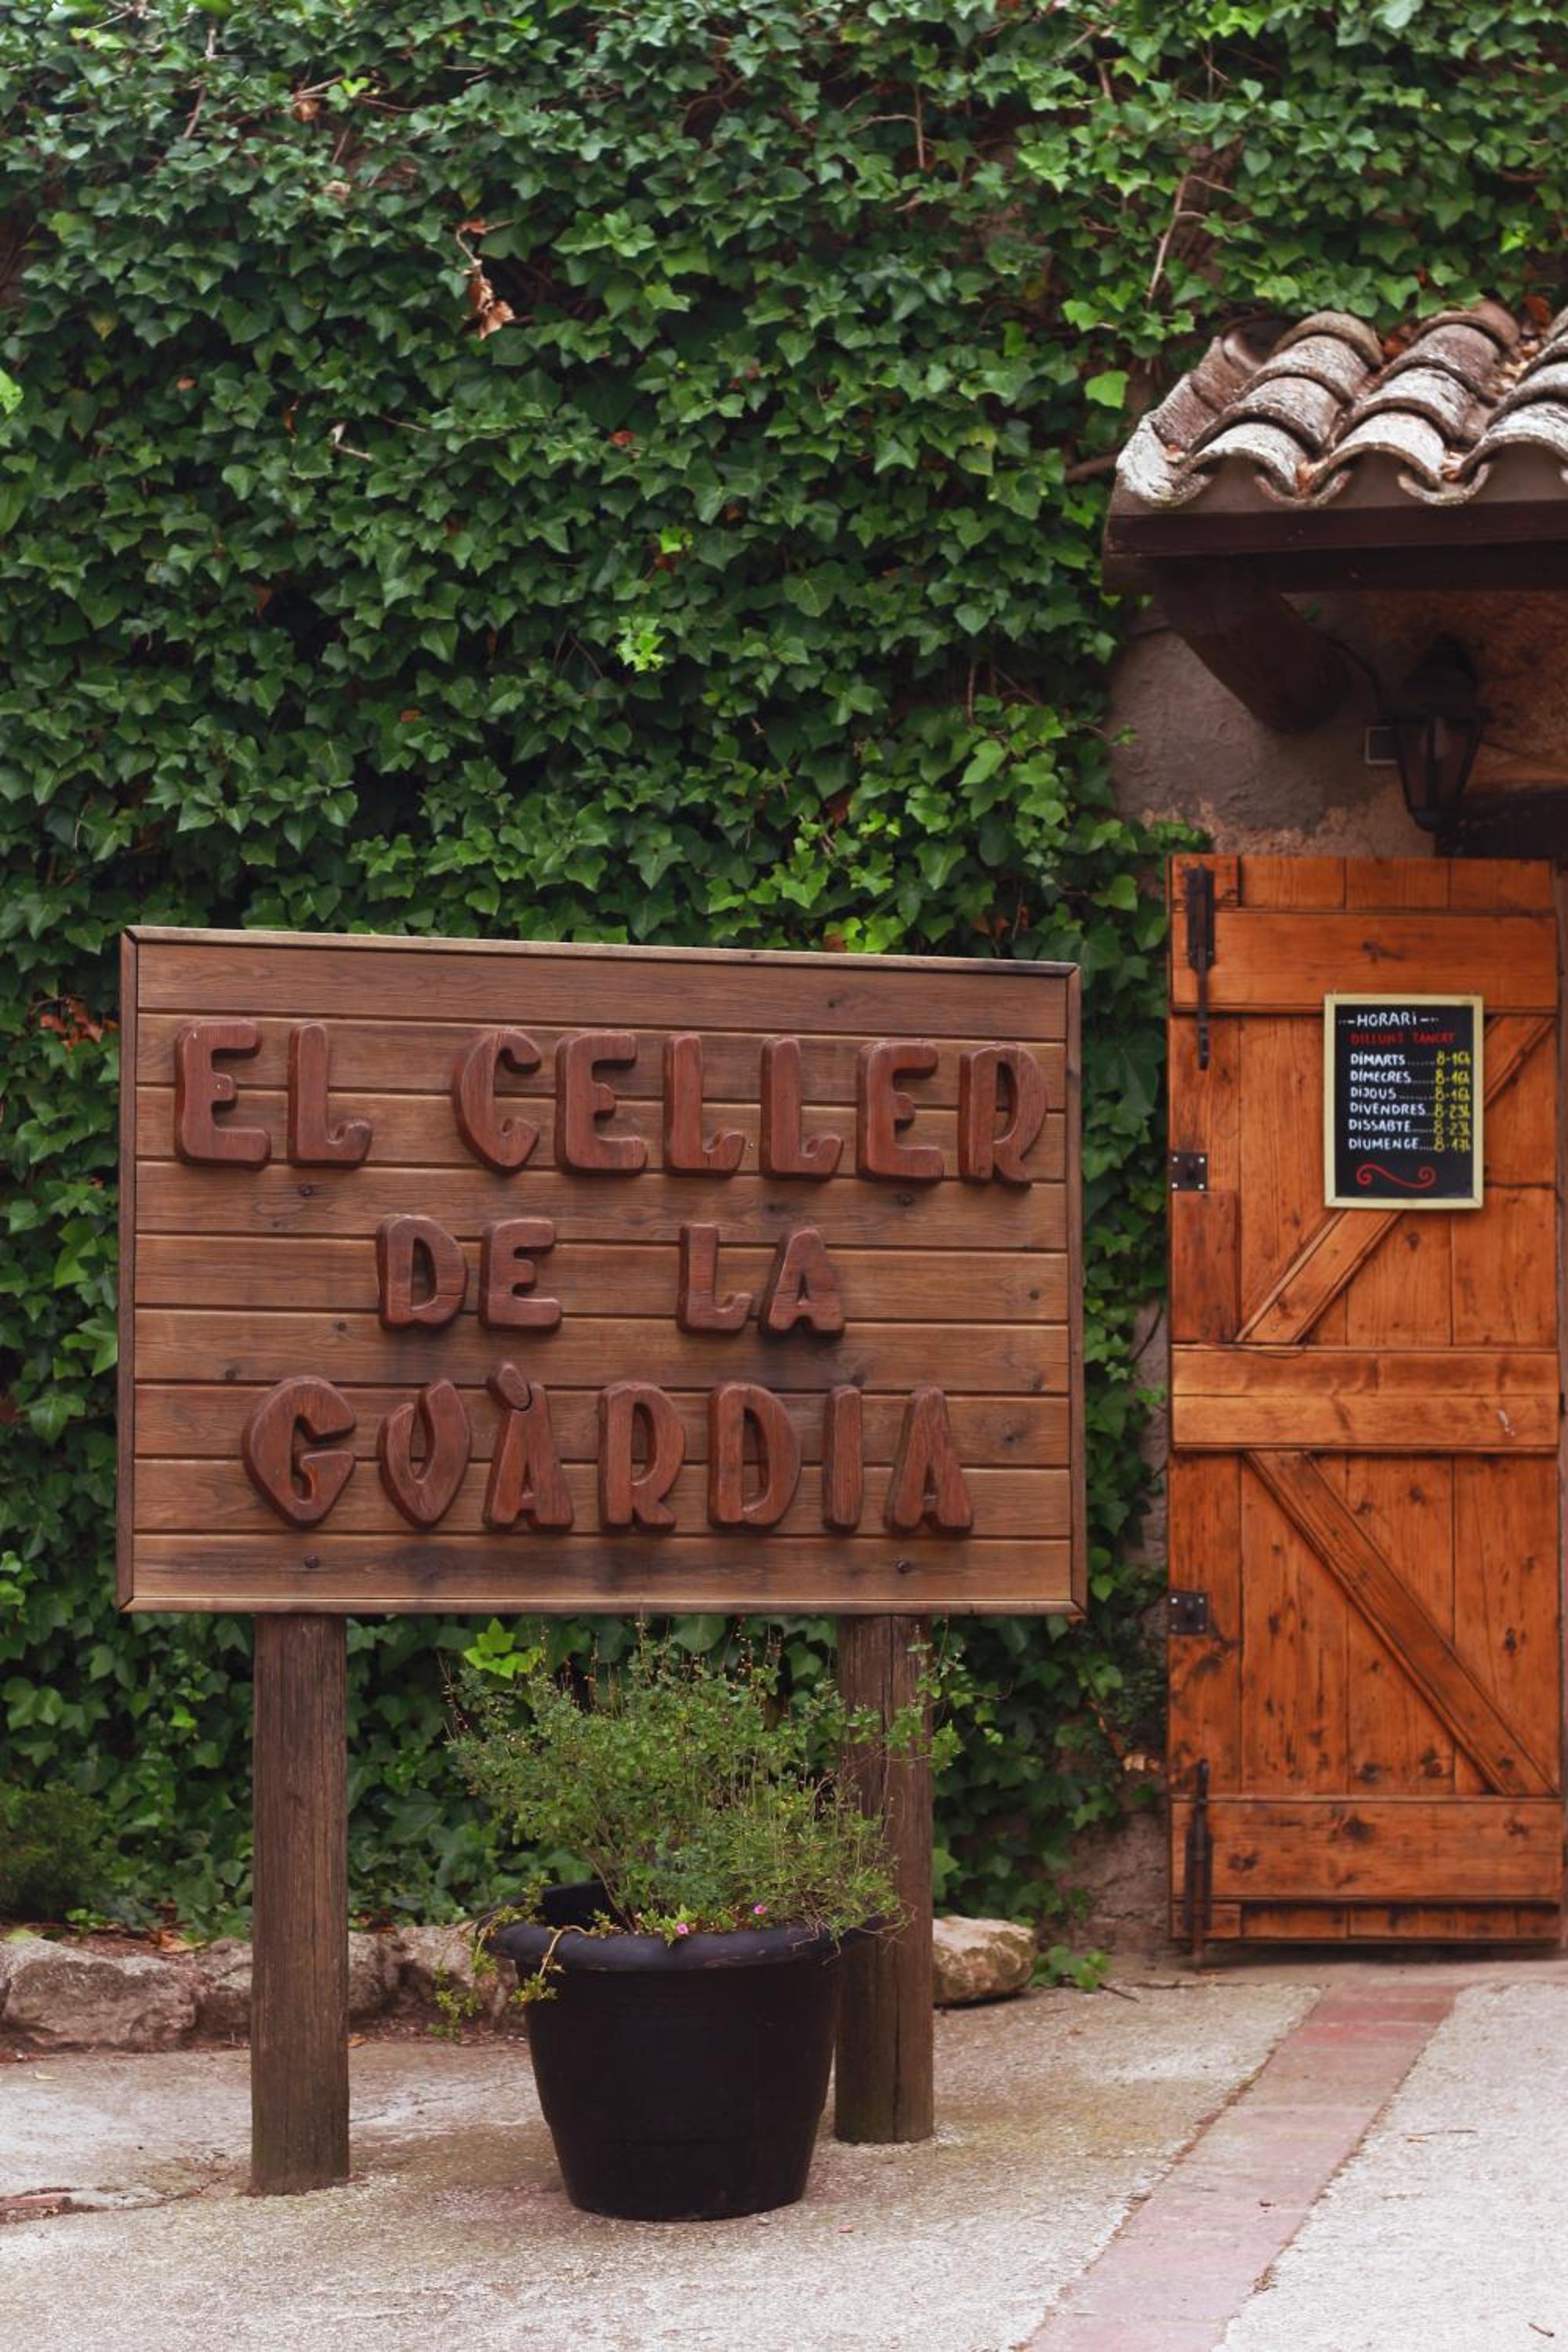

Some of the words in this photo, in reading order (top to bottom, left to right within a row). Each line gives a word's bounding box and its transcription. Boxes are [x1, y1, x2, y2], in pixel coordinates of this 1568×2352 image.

[1350, 1051, 1406, 1066] DIMARTS
[1350, 1069, 1411, 1083] DIMECRES
[1350, 1087, 1396, 1100] DIJOUS
[172, 1018, 374, 1171] EL
[452, 1028, 1050, 1189] CELLER
[1349, 1102, 1426, 1116] DIVENDRES
[1348, 1119, 1411, 1132] DISSABTE
[1348, 1138, 1418, 1150] DIUMENGE
[376, 1213, 563, 1332] DE
[677, 1222, 847, 1338] LA
[241, 1360, 974, 1537] GUÀRDIA
